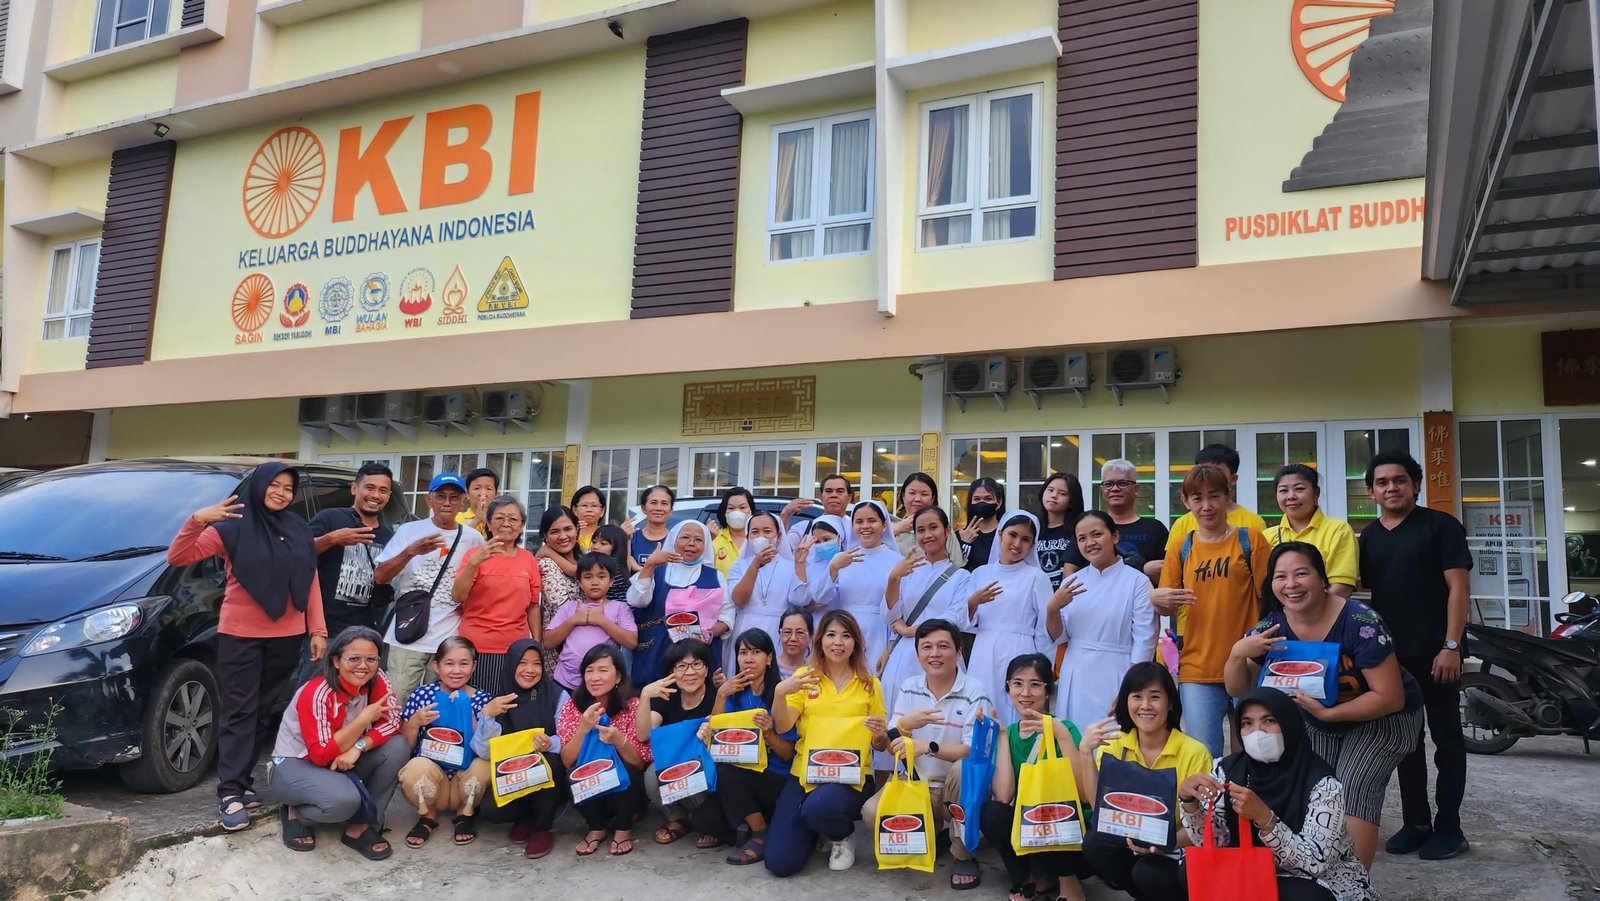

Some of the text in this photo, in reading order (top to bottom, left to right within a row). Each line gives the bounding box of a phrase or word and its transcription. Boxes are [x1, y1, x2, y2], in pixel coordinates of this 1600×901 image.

[332, 90, 541, 223] KBI
[1225, 206, 1342, 241] PUSDIKLAT
[238, 209, 536, 269] KELUARGA BUDDHAYANA INDONESIA
[356, 313, 389, 324] WULAN
[404, 318, 422, 328] WBI
[437, 314, 468, 326] SIDDHI
[325, 325, 341, 336] MBI
[355, 322, 388, 333] BAHAGIA
[235, 332, 263, 345] SAGIN
[1489, 514, 1522, 526] KBI
[1194, 556, 1230, 583] H&M
[1274, 676, 1300, 688] KBI
[429, 741, 450, 753] KBI
[718, 744, 740, 755] KBI
[816, 765, 841, 777] KBI
[504, 771, 529, 785] KBI
[579, 775, 600, 792] KBI
[667, 779, 689, 793] KBI
[1111, 810, 1144, 828] KBI
[1032, 824, 1058, 837] KBI
[888, 833, 908, 844] KBI
